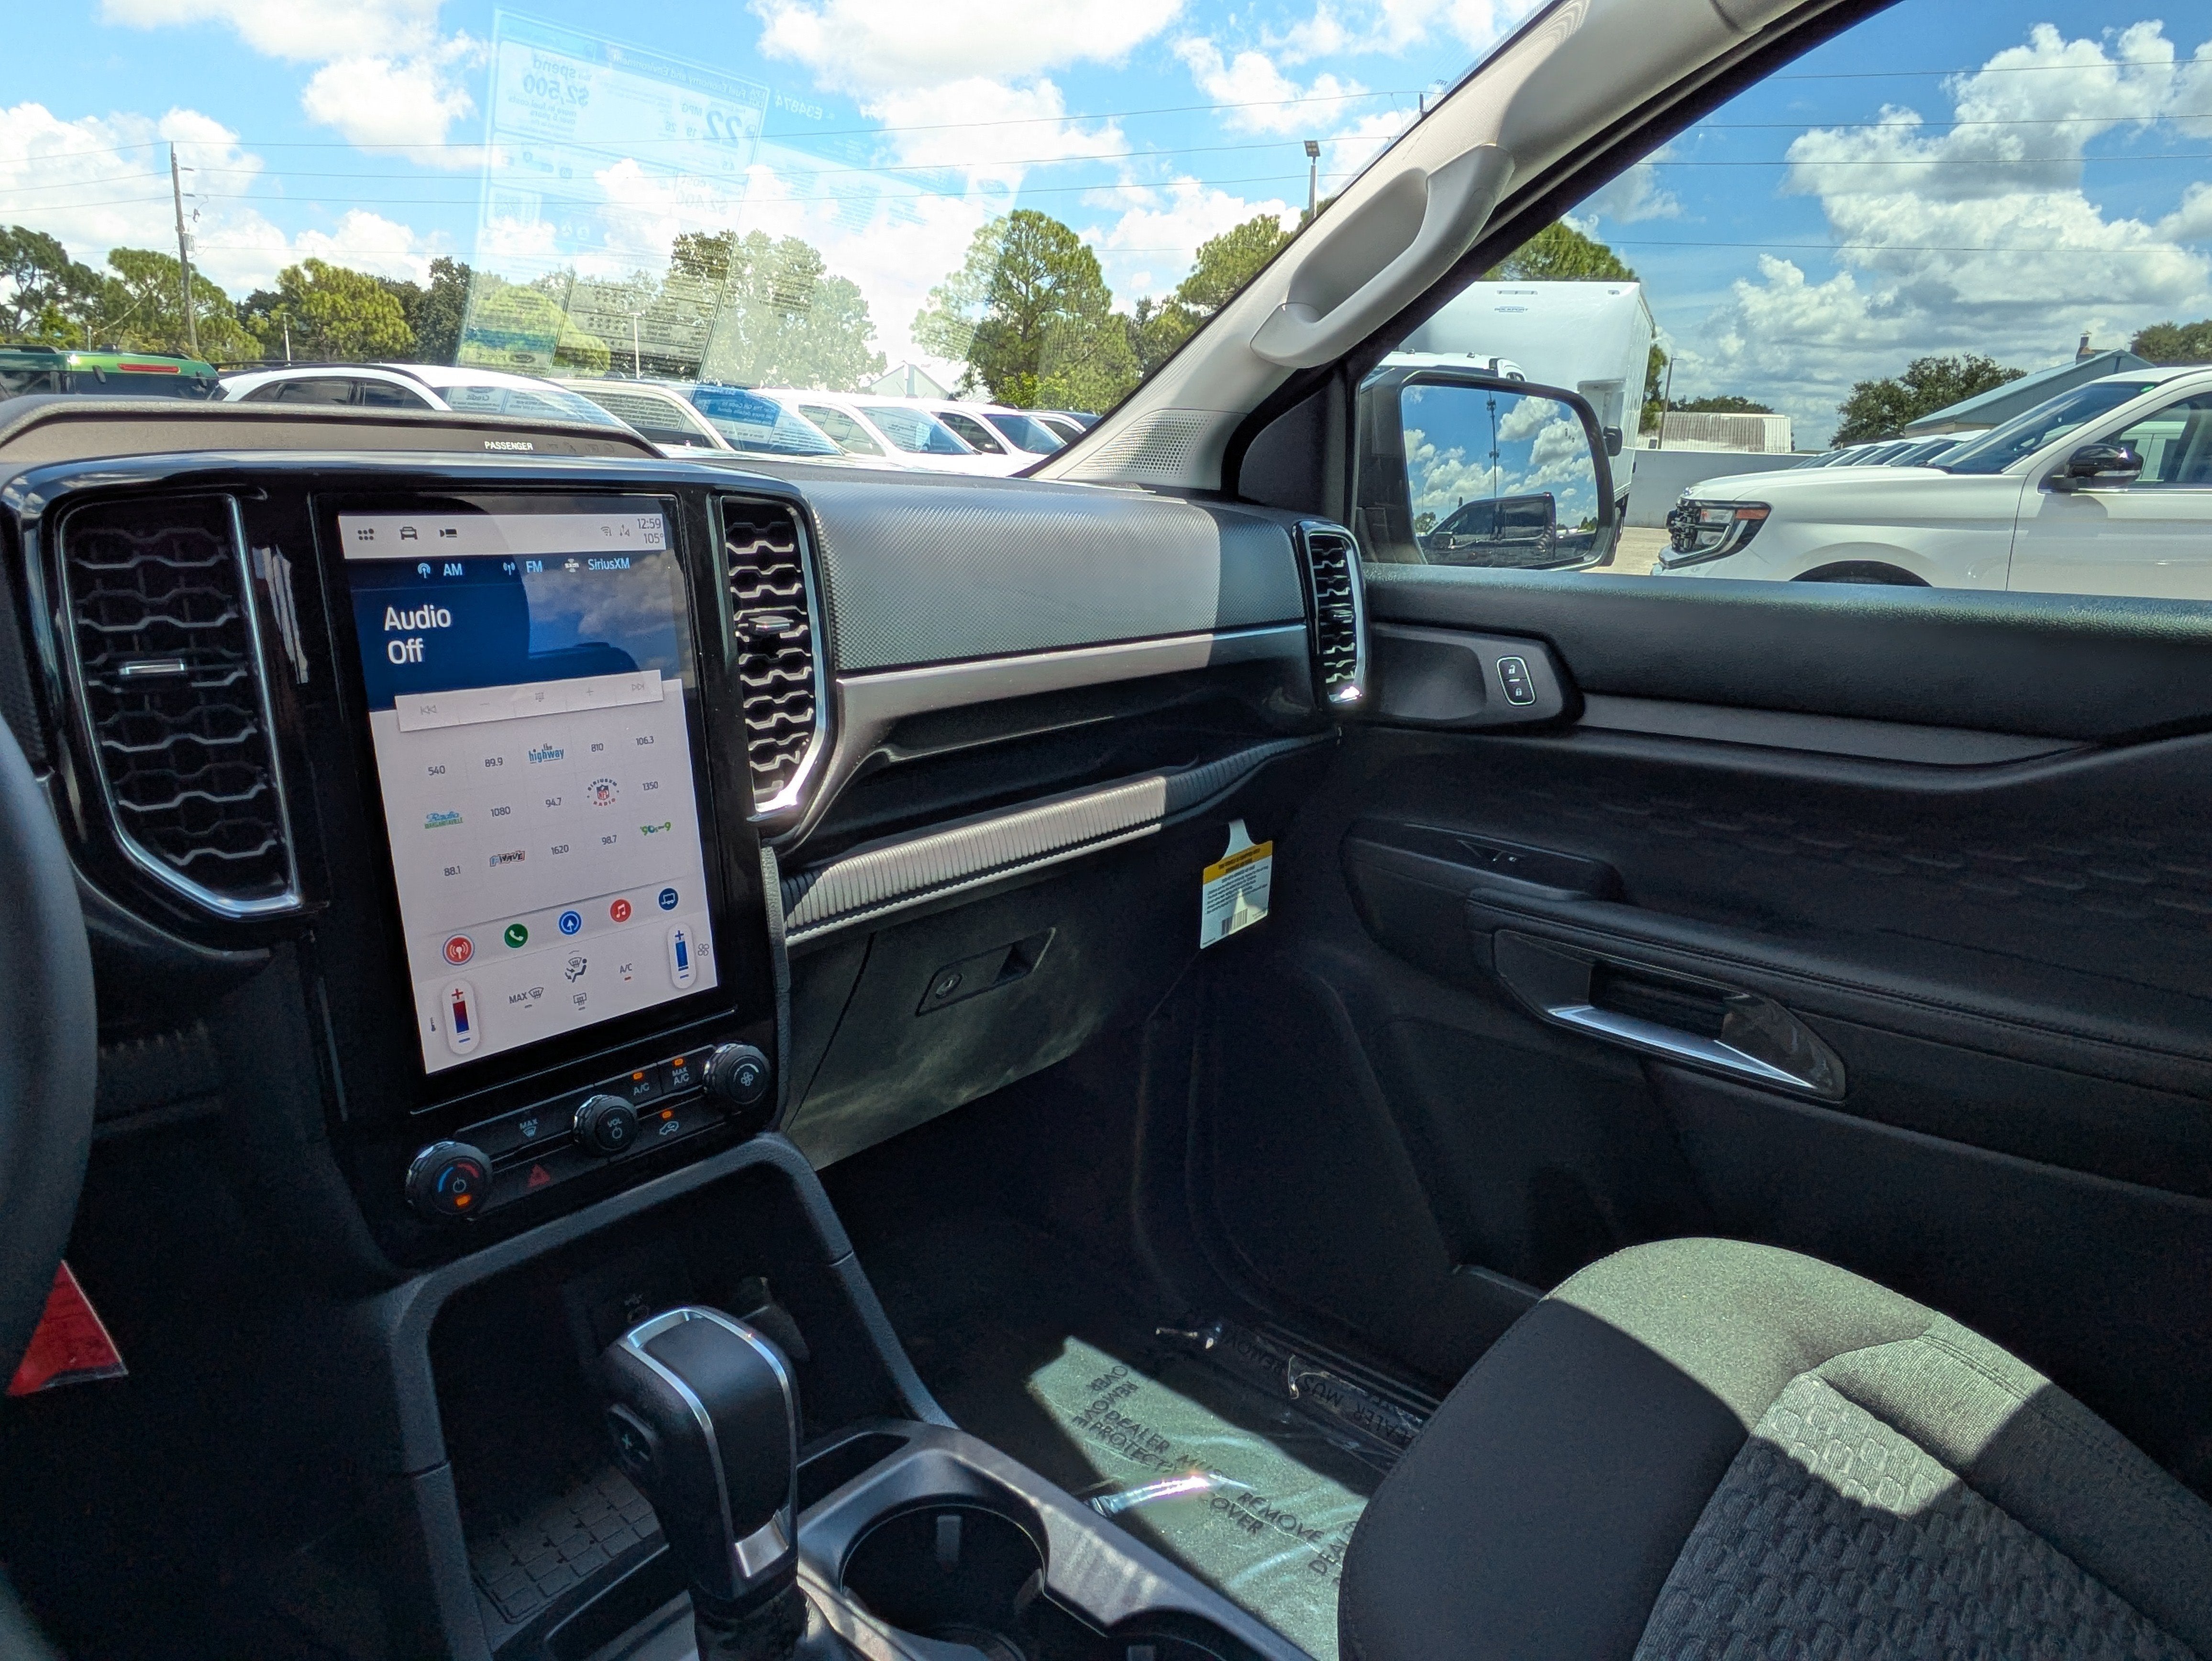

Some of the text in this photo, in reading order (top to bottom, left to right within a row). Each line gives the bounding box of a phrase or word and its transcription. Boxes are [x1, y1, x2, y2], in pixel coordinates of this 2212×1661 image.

[484, 441, 533, 450] PASSENGER
[637, 518, 662, 530] 12:59
[526, 560, 543, 573] FM
[588, 557, 630, 570] SiriusXM
[443, 564, 463, 576] AM
[384, 604, 452, 631] Audio
[387, 638, 424, 664] Off
[636, 736, 654, 745] 106.3
[591, 743, 604, 752] 810
[485, 757, 503, 767] 89.9
[529, 749, 564, 763] highway
[428, 765, 445, 775] 540
[642, 781, 659, 791] 1350
[545, 797, 562, 807] 94.7
[491, 806, 511, 817] 1080
[602, 835, 617, 845] 98.7
[551, 844, 569, 855] 1620
[444, 865, 462, 877] 88.1
[619, 963, 633, 974] A/C
[509, 992, 528, 1004] MAX
[672, 1067, 687, 1076] MAX
[674, 1073, 690, 1085] A/C
[634, 1083, 650, 1096] A/C
[520, 1118, 539, 1130] MAX
[608, 1118, 623, 1128] VOL
[1103, 1410, 1170, 1453] DEALER
[1237, 1492, 1325, 1543] REMOVE
